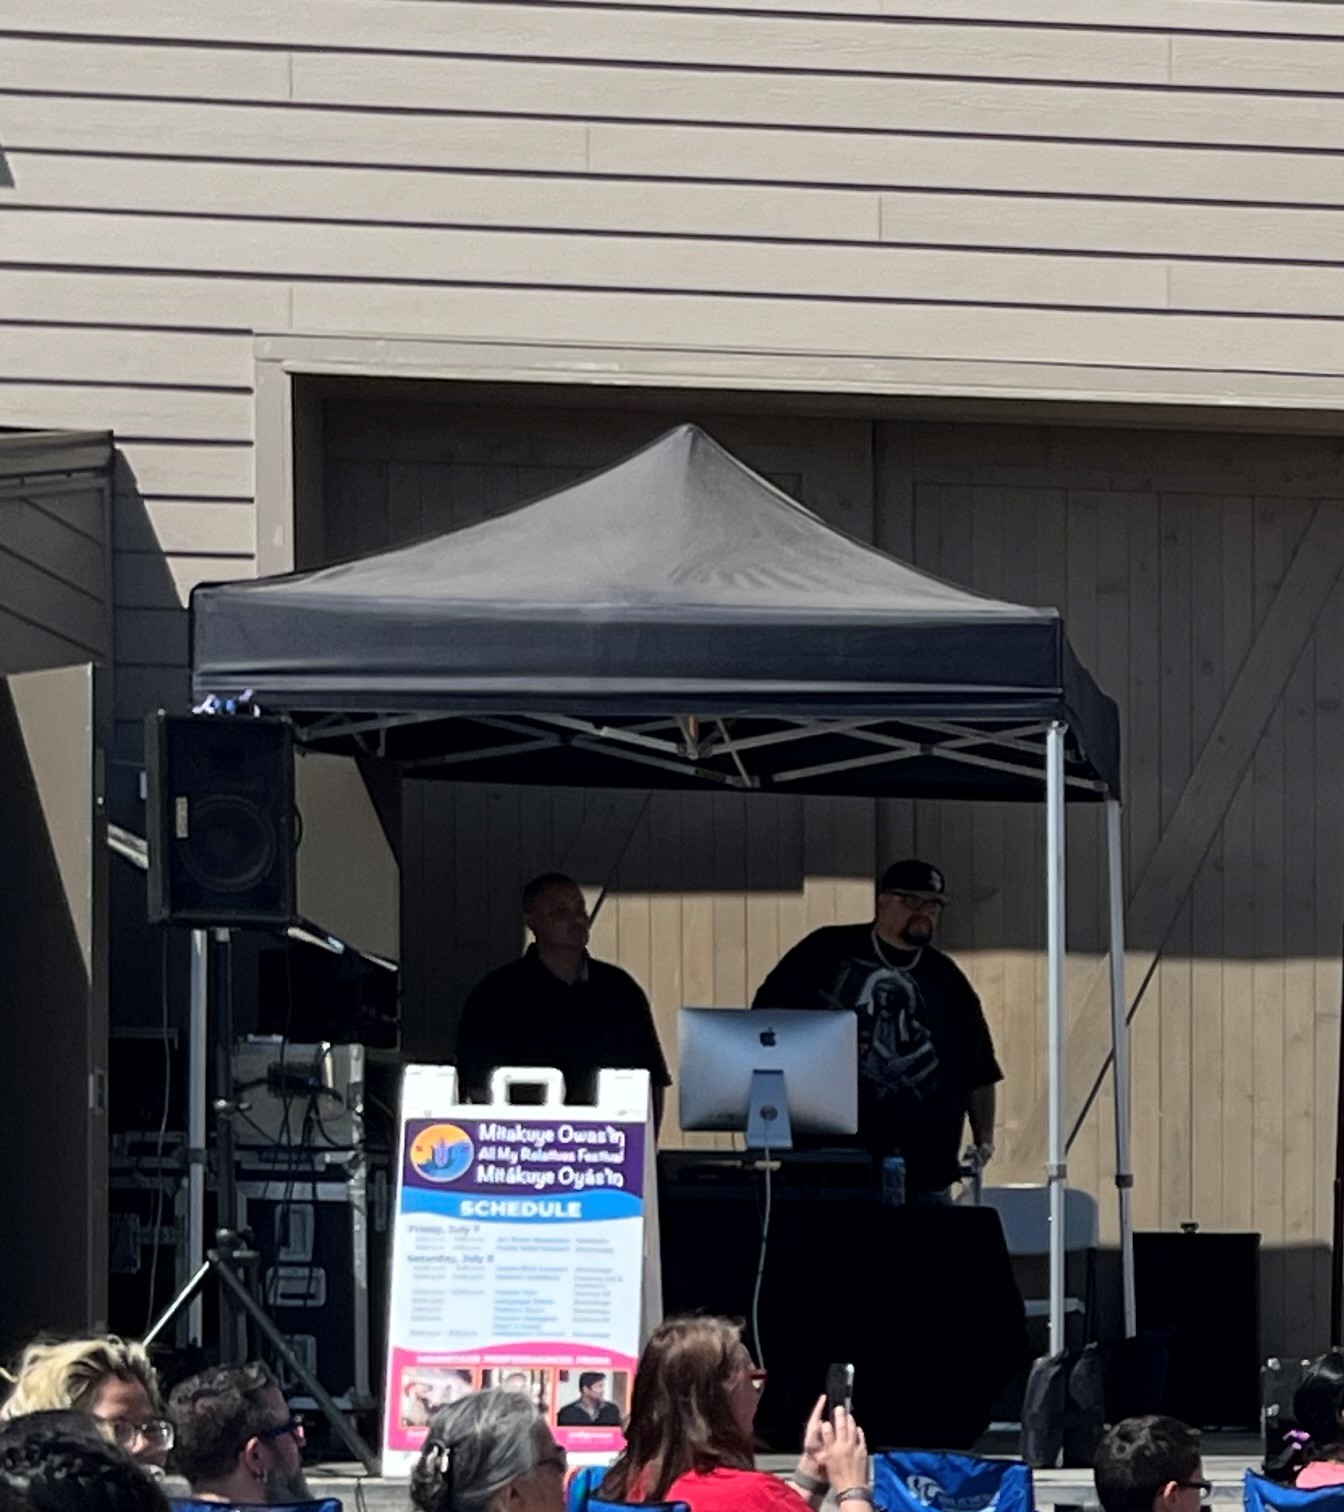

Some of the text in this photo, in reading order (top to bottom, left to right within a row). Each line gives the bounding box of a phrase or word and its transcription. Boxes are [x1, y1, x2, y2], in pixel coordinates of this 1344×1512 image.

[477, 1146, 496, 1161] All
[498, 1148, 519, 1164] My
[460, 1200, 582, 1218] SCHEDULE
